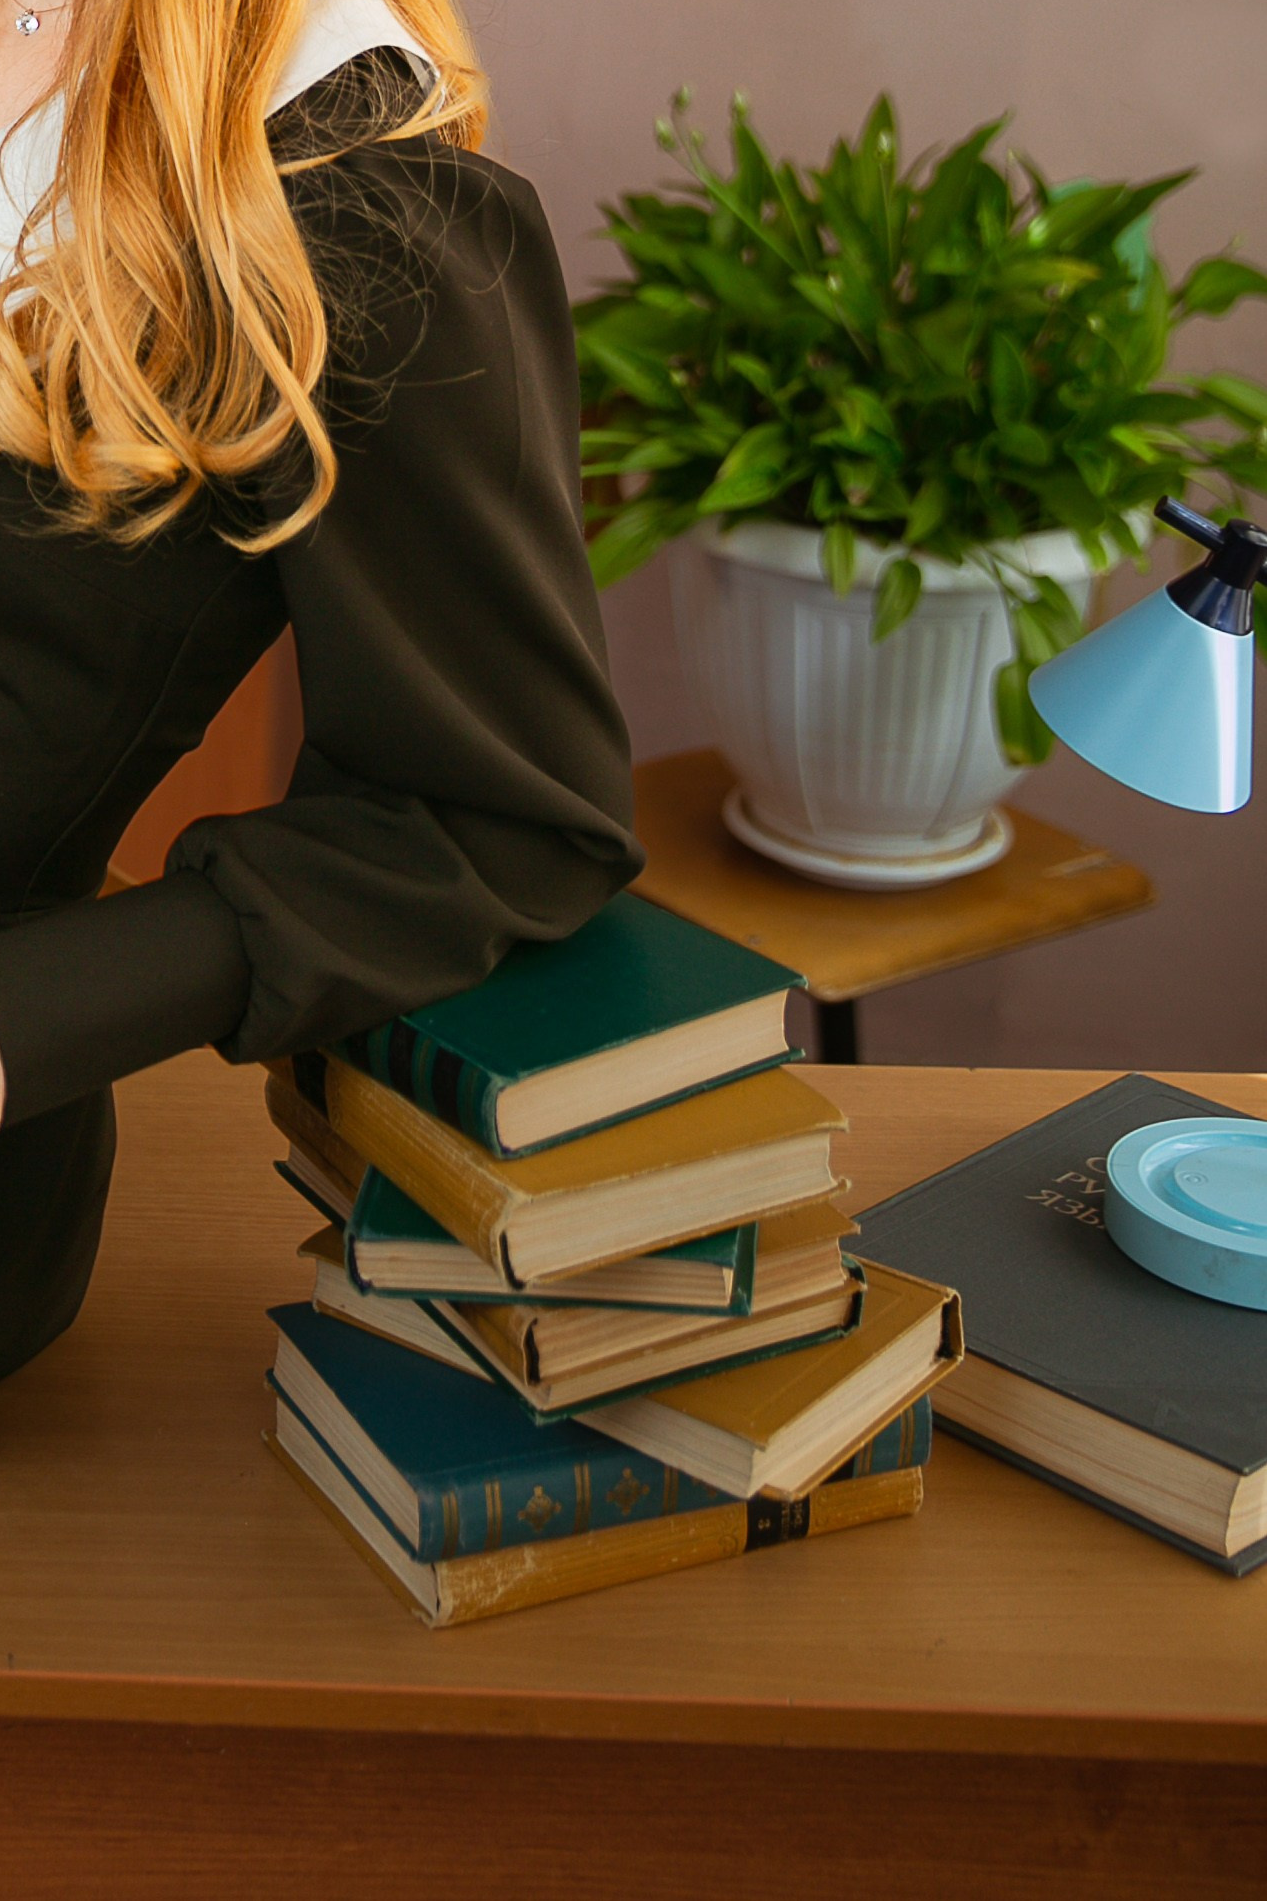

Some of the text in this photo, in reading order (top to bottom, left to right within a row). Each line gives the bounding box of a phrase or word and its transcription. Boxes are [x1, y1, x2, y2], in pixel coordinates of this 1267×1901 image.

[1085, 1157, 1107, 1174] С
[1052, 1171, 1106, 1193] РУ
[1025, 1188, 1105, 1228] ЯЗЫ
